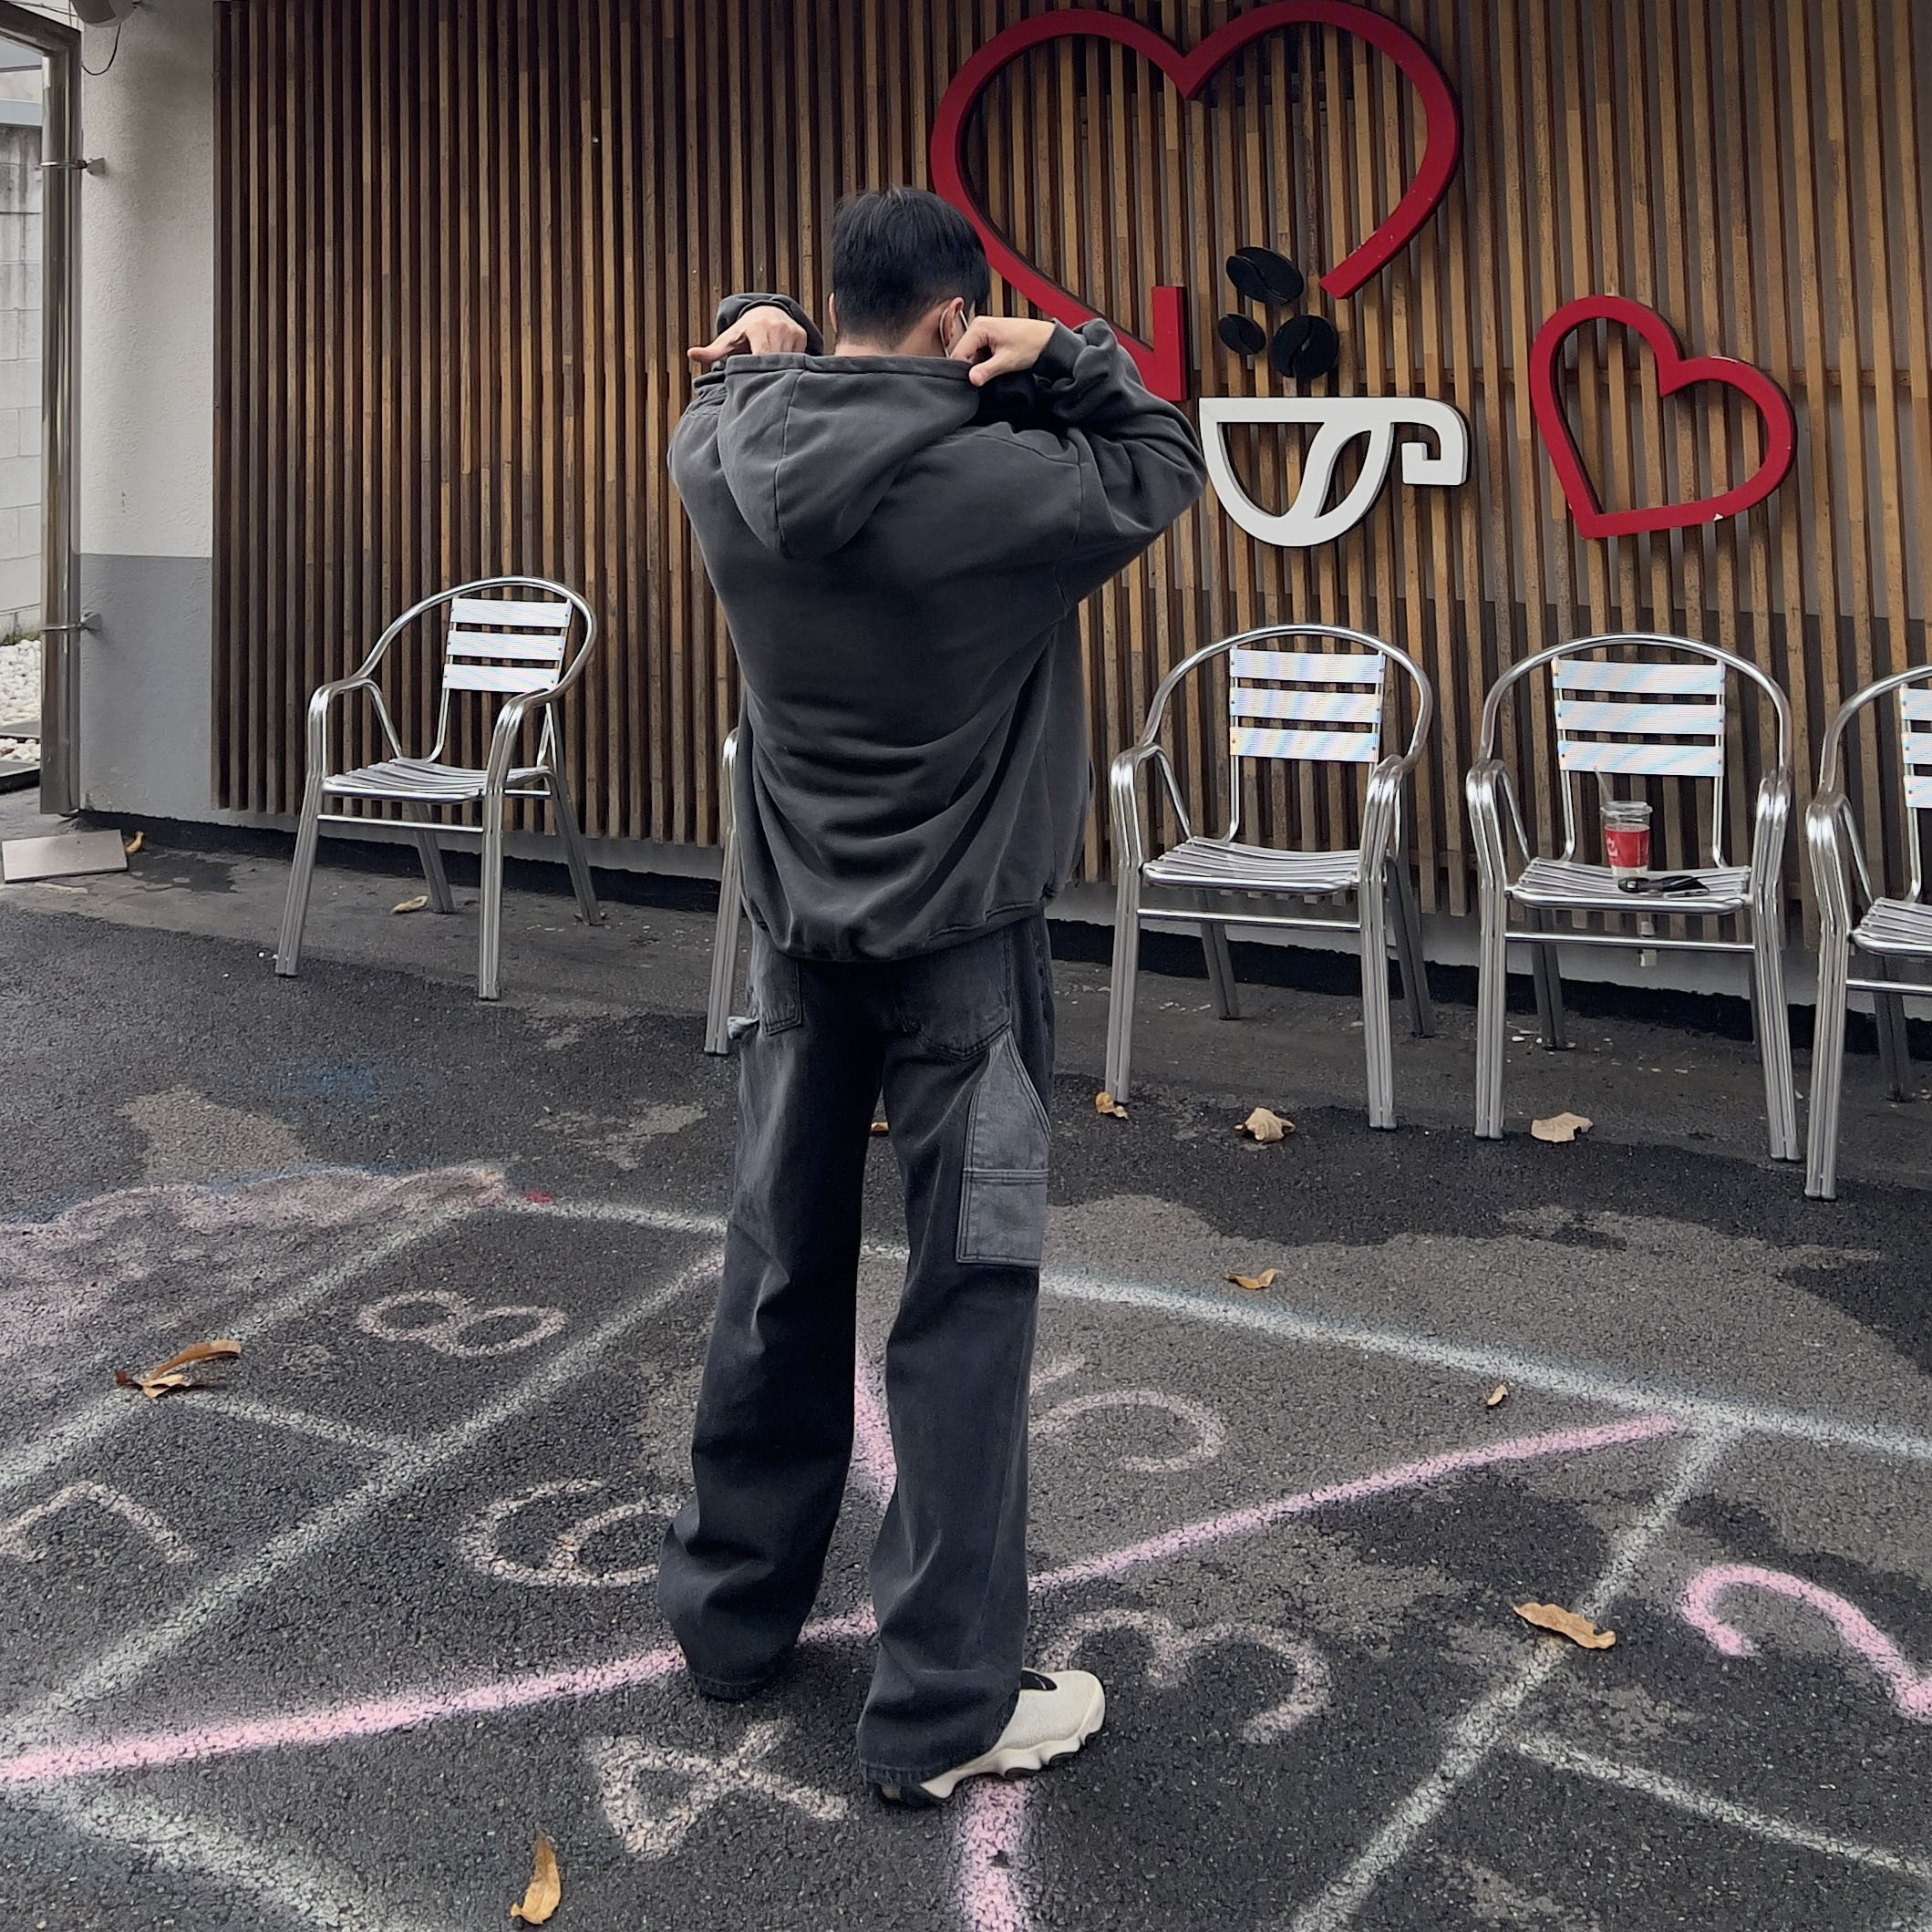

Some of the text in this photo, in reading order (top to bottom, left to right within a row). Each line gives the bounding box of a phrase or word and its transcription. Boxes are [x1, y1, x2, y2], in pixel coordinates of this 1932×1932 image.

[360, 1287, 568, 1358] 8
[459, 1477, 684, 1588] 6
[1039, 1607, 1333, 1745] 3
[586, 1718, 852, 1860] 4
